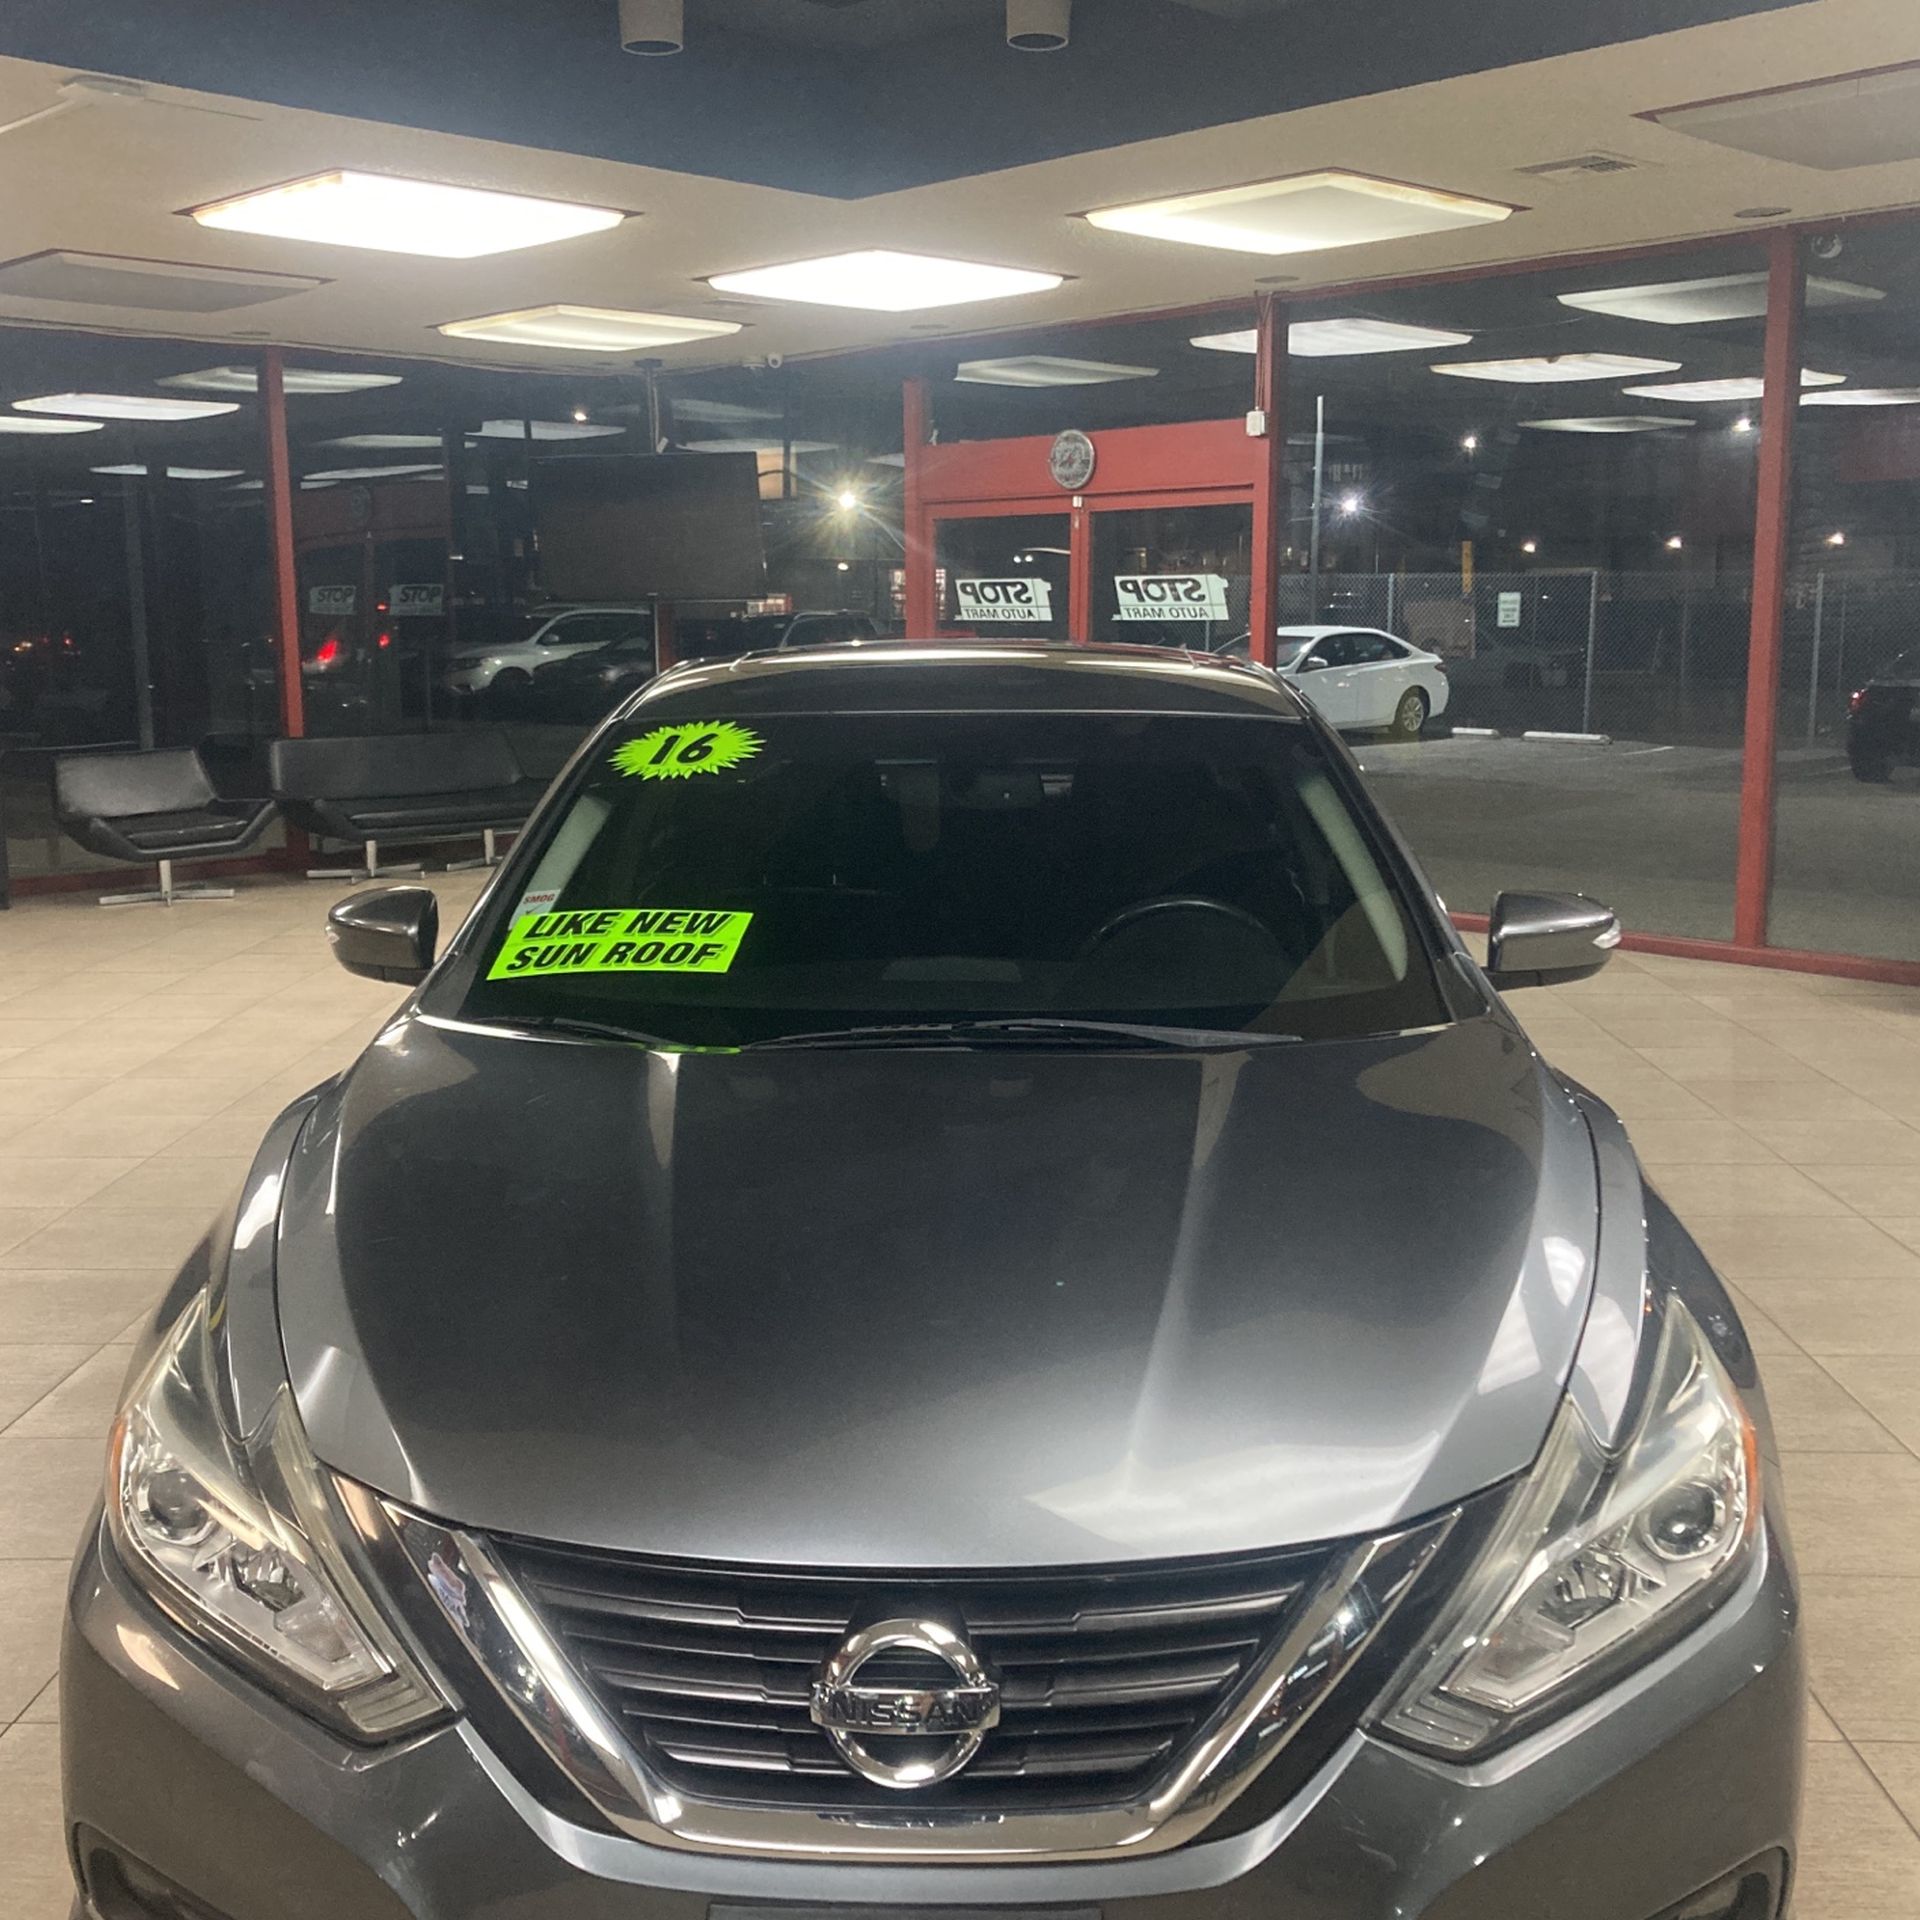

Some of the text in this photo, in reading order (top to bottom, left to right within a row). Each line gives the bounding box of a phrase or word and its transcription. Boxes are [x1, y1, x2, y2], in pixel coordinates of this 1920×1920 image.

[648, 733, 719, 766] 16
[523, 912, 733, 940] LIKE NEW
[506, 942, 724, 972] SUN ROOF
[827, 1690, 985, 1727] NISSAN
